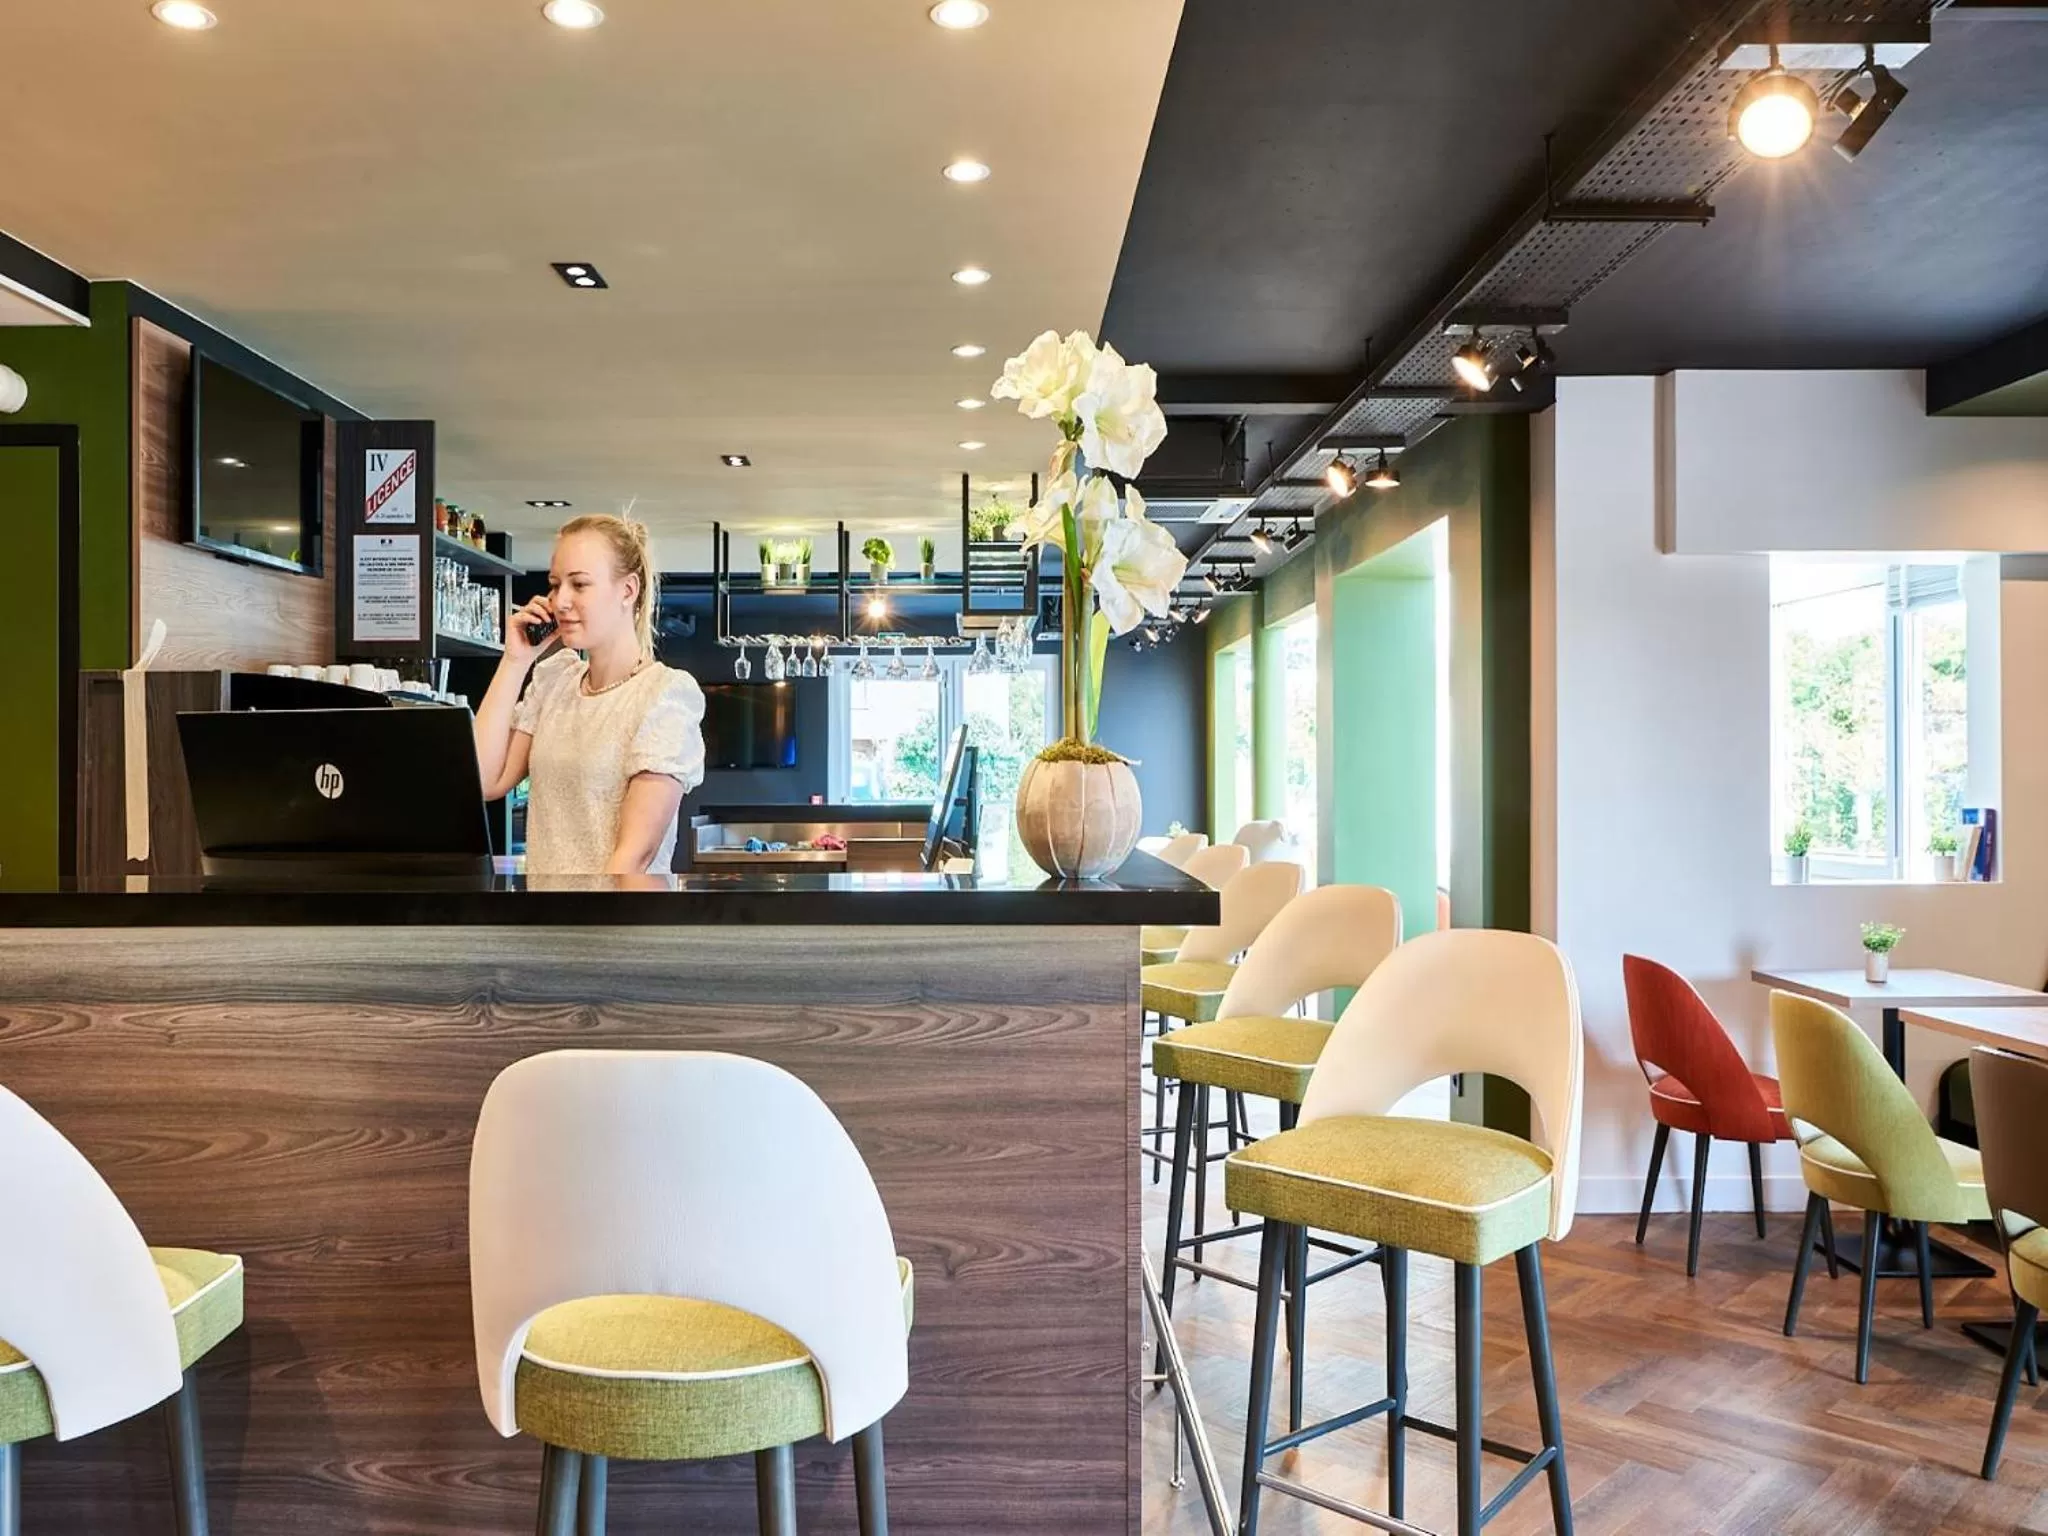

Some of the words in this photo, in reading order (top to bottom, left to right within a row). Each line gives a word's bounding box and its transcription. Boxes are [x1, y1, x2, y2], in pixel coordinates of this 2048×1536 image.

[370, 453, 388, 472] IV
[366, 455, 414, 517] LICENCE
[320, 763, 341, 799] hp
